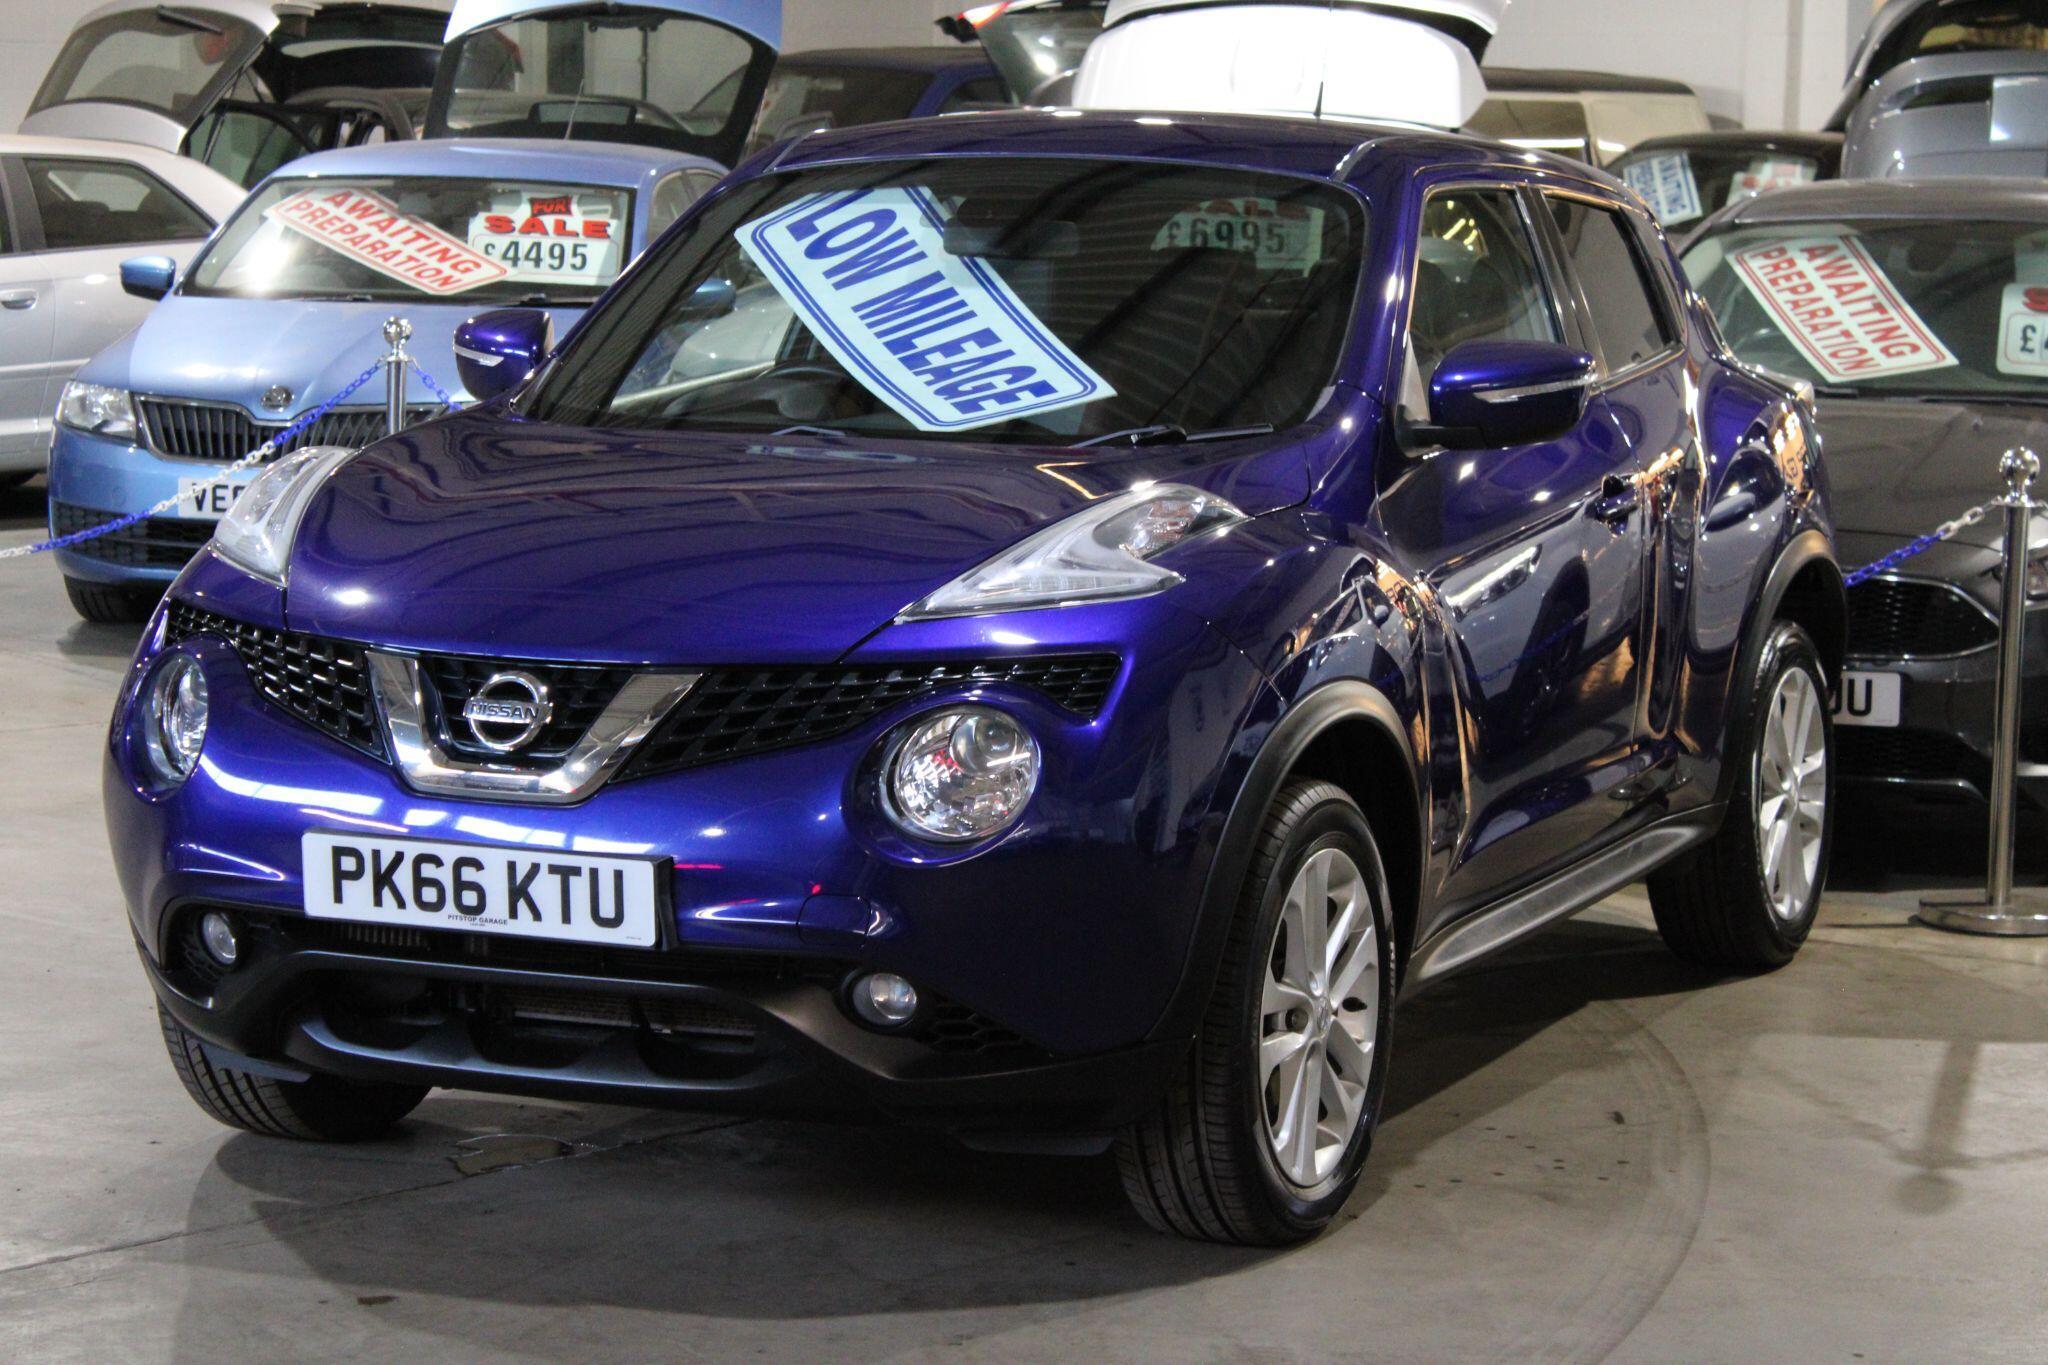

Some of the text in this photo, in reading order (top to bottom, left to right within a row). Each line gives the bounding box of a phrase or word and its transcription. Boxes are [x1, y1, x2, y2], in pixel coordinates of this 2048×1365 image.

[286, 200, 462, 288] PREPARATION
[322, 190, 481, 275] AWAITING
[484, 215, 611, 239] SALE
[1167, 218, 1285, 253] £6995
[785, 189, 1058, 415] LOW MILEAGE
[1751, 246, 1881, 371] PREPARATION
[1800, 244, 1921, 359] AWAITING
[470, 702, 539, 719] NISSAN
[331, 845, 625, 929] PK66 KTU
[447, 914, 478, 923] PITSTOP
[479, 917, 509, 926] GARAGE
